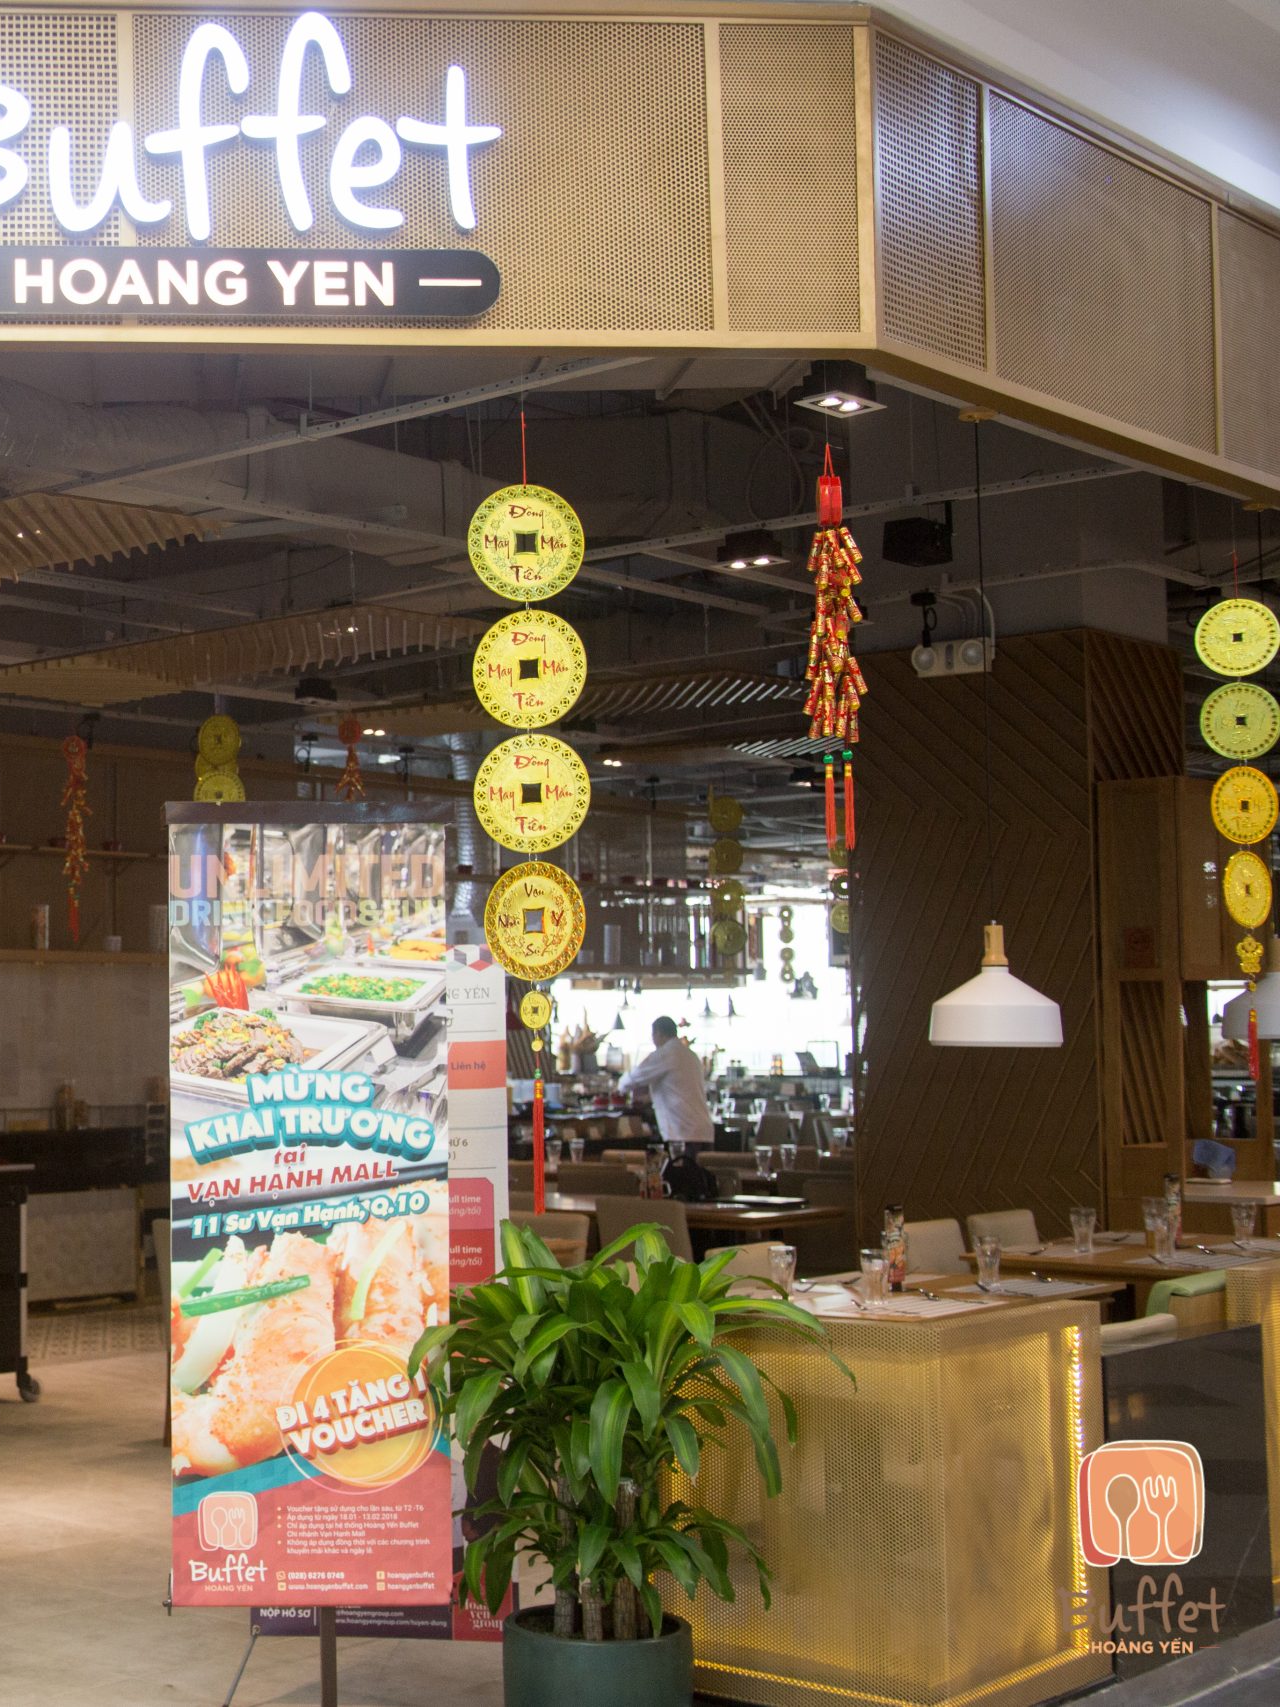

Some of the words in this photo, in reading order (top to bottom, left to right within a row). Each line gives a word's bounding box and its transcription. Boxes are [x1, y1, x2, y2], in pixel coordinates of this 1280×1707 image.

[14, 259, 248, 304] HOANG
[267, 261, 394, 306] YEN
[171, 854, 443, 898] UNLIMITED
[250, 1066, 371, 1104] MỪNG
[189, 1109, 275, 1152] KHAI
[281, 1107, 432, 1149] TRƯƠNG
[188, 1178, 240, 1205] VẠN
[250, 1168, 322, 1198] HẠNH
[330, 1160, 397, 1184] MALL
[225, 1213, 255, 1232] Sư
[257, 1210, 299, 1232] Vạn
[371, 1192, 425, 1216] Q.10
[276, 1402, 309, 1430] ĐI
[313, 1396, 329, 1419] 4
[289, 1400, 428, 1454] VOUCHER
[188, 1553, 268, 1583] Buffet
